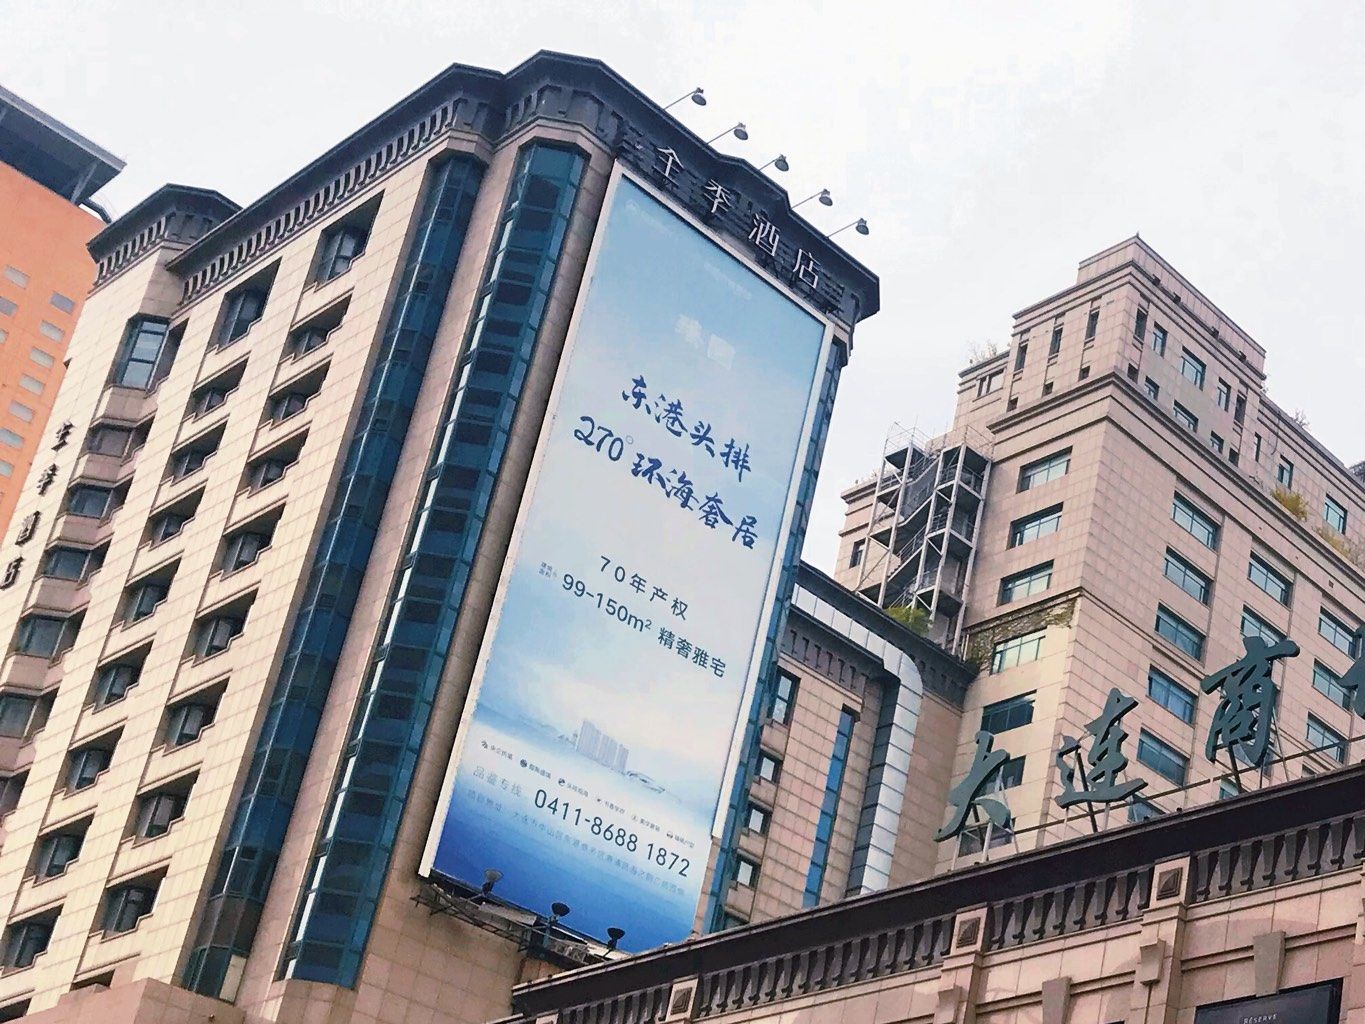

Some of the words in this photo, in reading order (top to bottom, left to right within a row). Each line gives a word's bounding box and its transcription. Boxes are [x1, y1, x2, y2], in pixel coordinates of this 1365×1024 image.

[653, 146, 819, 289] 全季酒店
[621, 374, 752, 482] 东港头排
[600, 555, 689, 621] 70年产权
[657, 626, 727, 678] 精奢雅宅
[534, 788, 638, 853] 0411-8688
[646, 842, 691, 878] 1872
